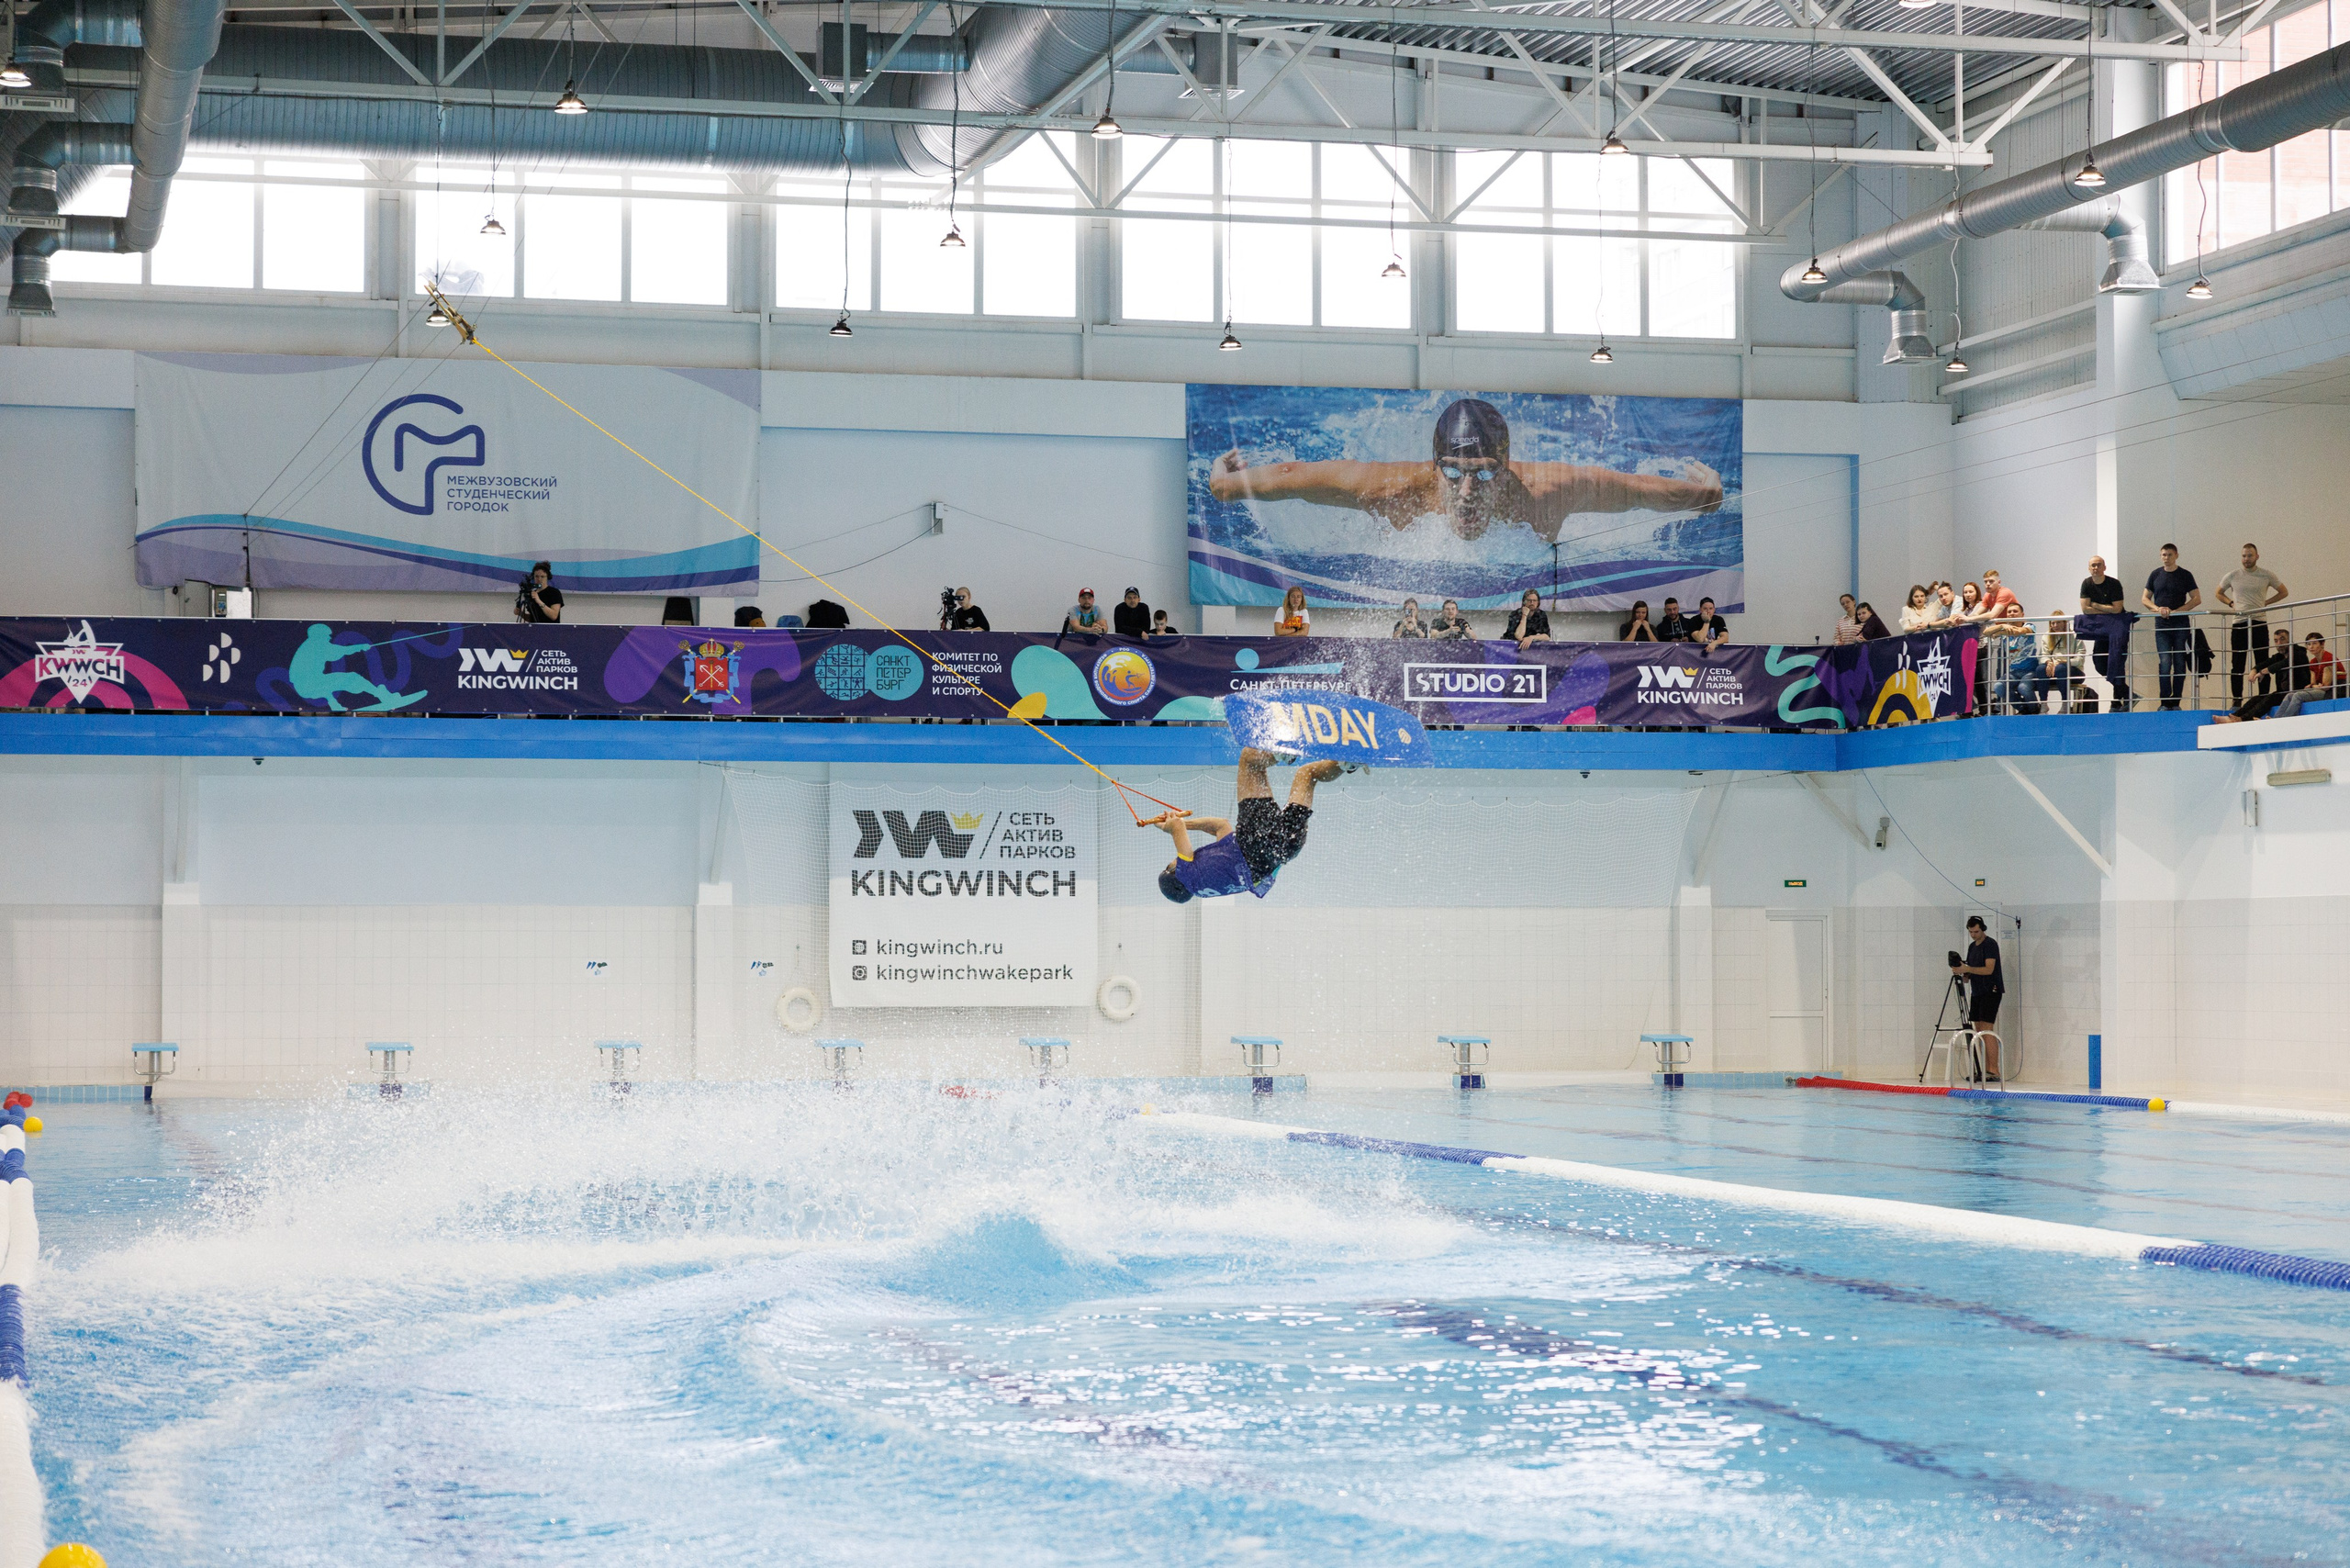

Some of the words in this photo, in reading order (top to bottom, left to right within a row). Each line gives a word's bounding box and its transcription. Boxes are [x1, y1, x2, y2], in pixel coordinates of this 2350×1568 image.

[447, 476, 557, 487] МЕЖВУЗОВСКИЙ
[447, 488, 550, 500] СТУДЕНЧЕСКИЙ
[447, 501, 509, 512] ГОРОДОК
[876, 655, 911, 666] САНКТ
[932, 652, 980, 661] КОМИТЕТ
[982, 654, 998, 662] ПО
[39, 657, 120, 679] KWWCH
[876, 667, 912, 678] ПЕТЕР
[932, 663, 1002, 673] ФИЗИЧЕСКОЙ
[458, 675, 578, 690] KINGWINCH
[876, 679, 905, 690] БУРГ
[932, 676, 980, 684] КУЛЬТУРЕ
[1416, 673, 1505, 693] STUDIO
[1513, 675, 1535, 693] 21
[932, 687, 940, 695] И
[943, 687, 983, 696] СПОРТУ
[1638, 690, 1744, 705] KINGWINCH
[1009, 812, 1056, 826] СЕТЬ
[1002, 829, 1064, 843] АКТИВ
[1000, 846, 1077, 859] ПАРКОВ
[851, 869, 1077, 897] KINGWINCH
[877, 939, 1003, 958] kingwinch.ru
[877, 965, 1073, 983] kingwinchwakepark
